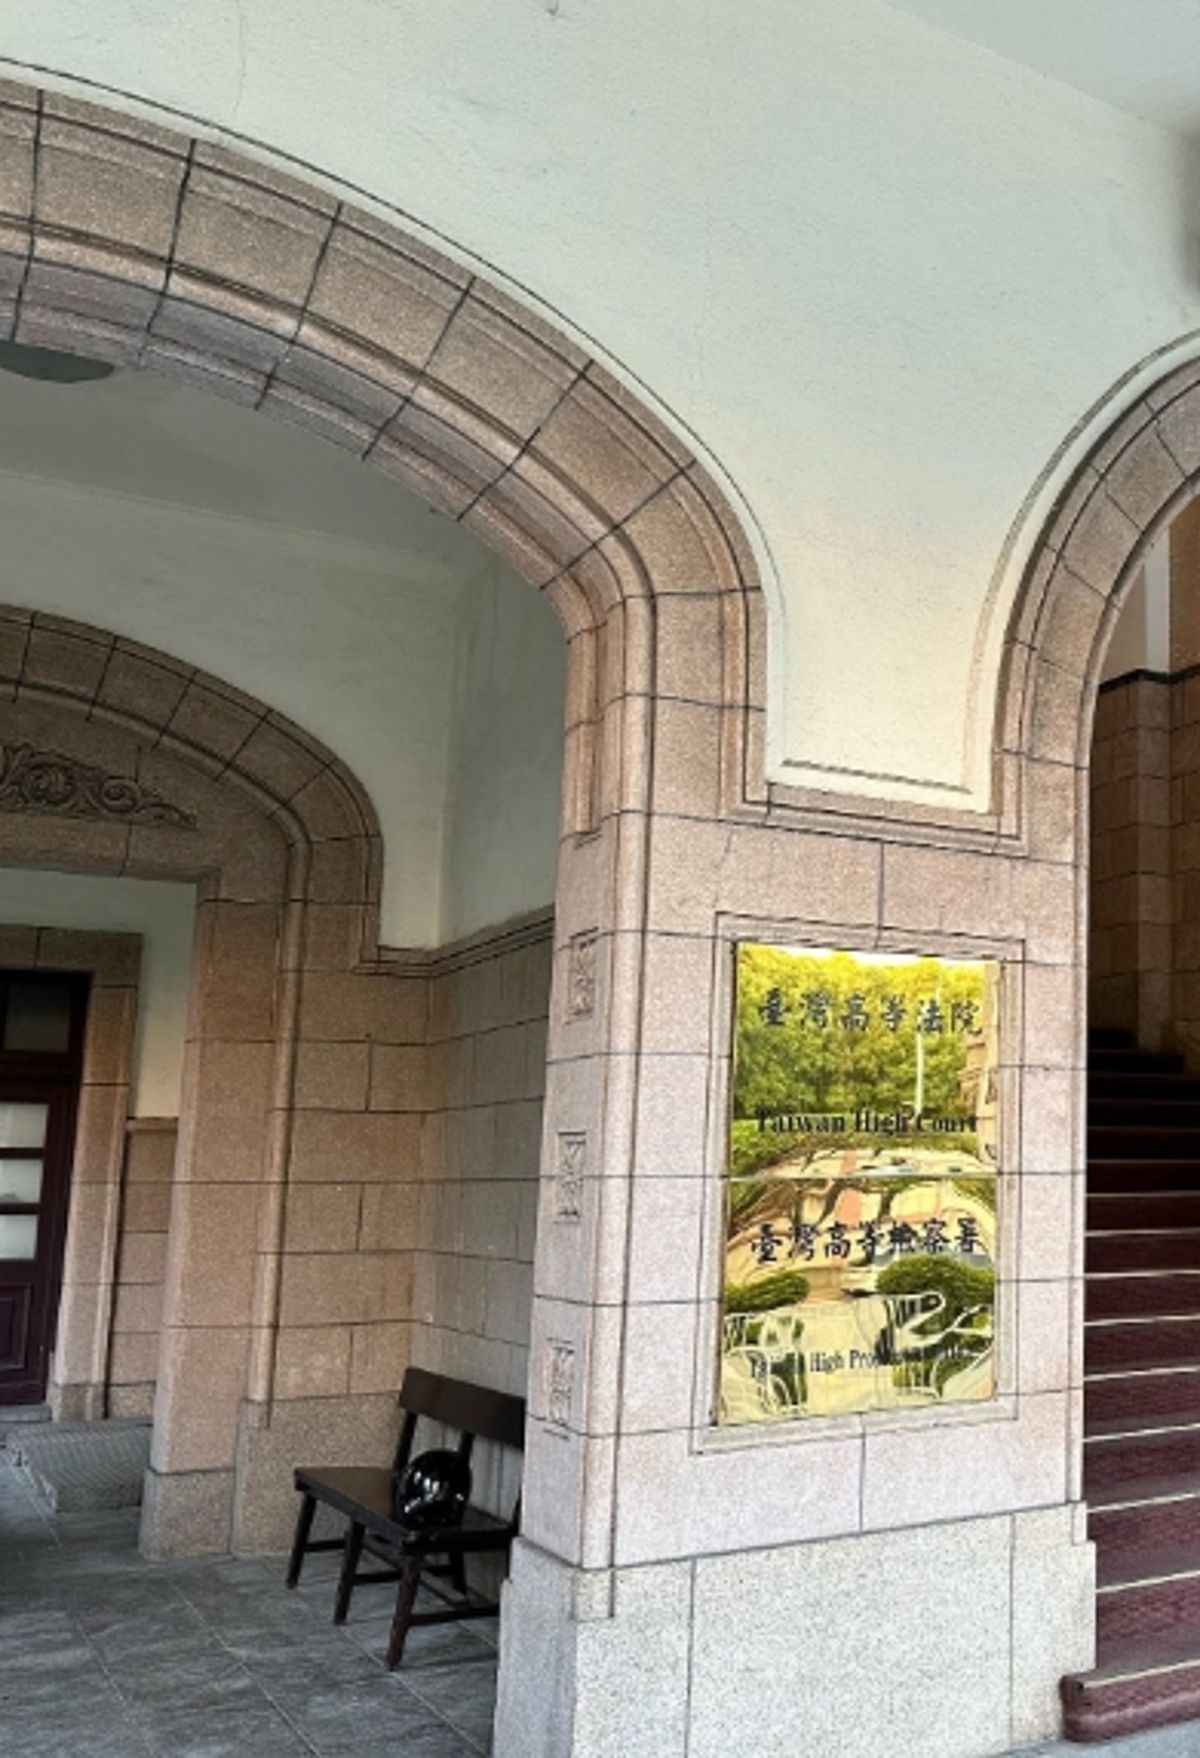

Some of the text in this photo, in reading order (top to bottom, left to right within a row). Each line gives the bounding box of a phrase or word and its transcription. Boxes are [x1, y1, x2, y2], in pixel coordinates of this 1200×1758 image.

[758, 987, 983, 1036] 臺灣高等法院
[755, 1108, 978, 1136] Taiwan High Court
[751, 1217, 981, 1264] 臺灣高等檢察署
[810, 1351, 844, 1375] High
